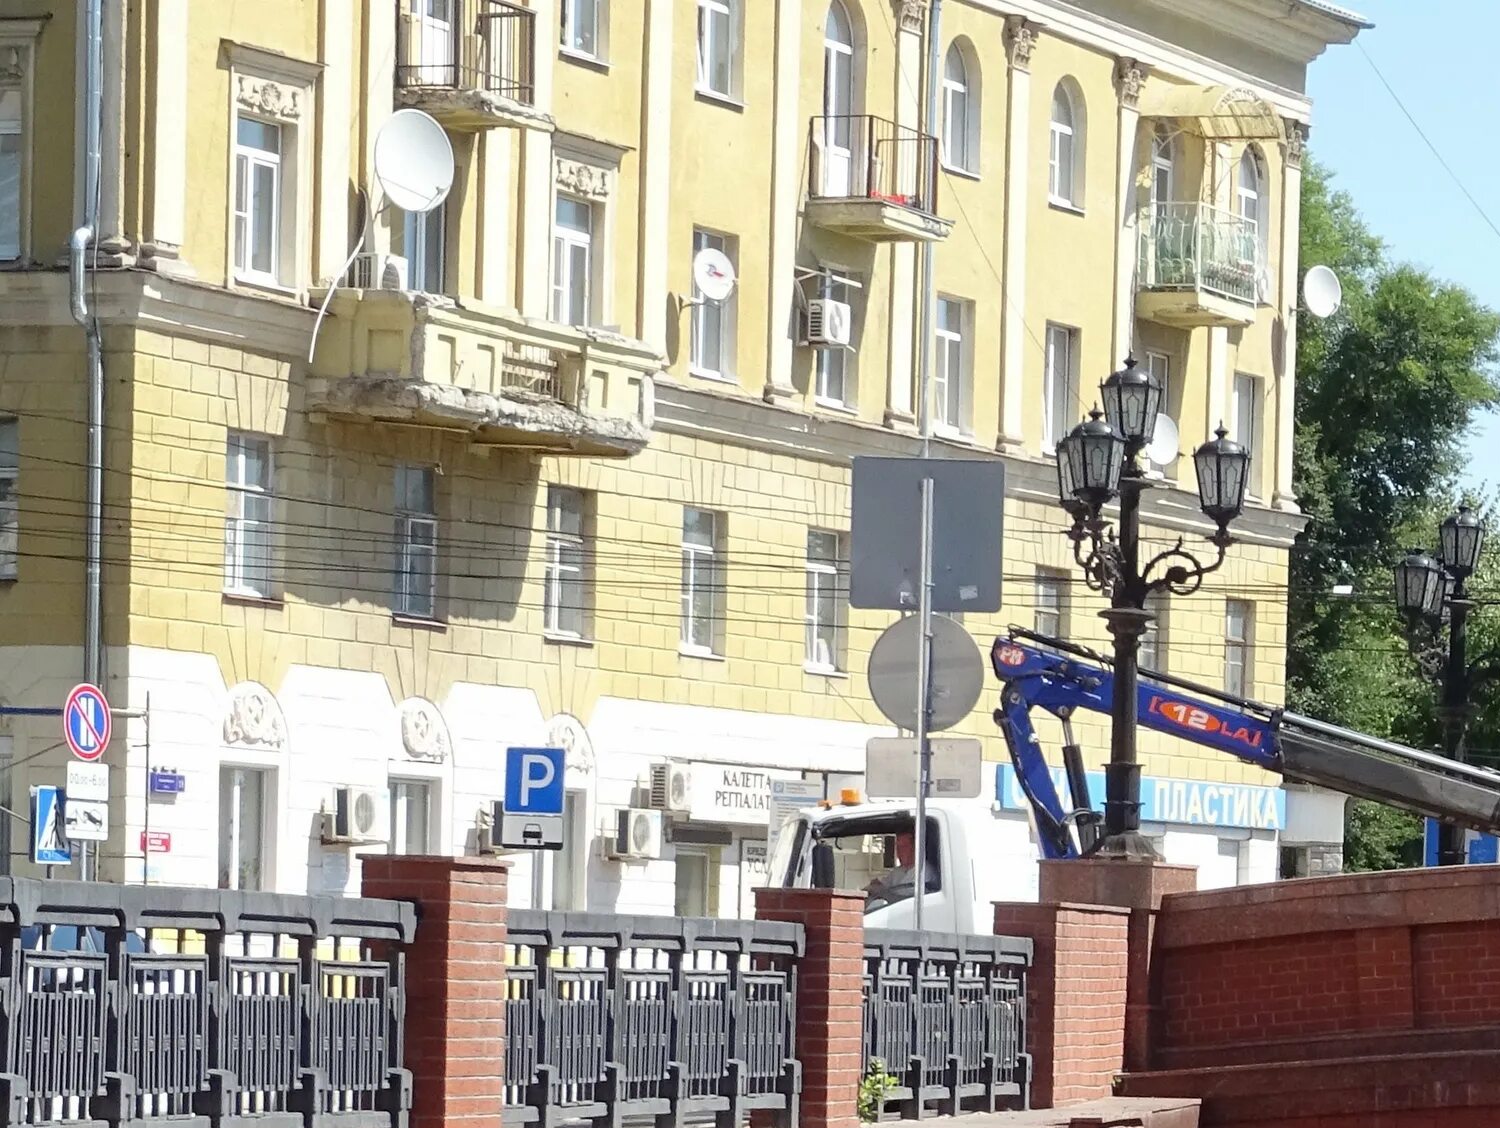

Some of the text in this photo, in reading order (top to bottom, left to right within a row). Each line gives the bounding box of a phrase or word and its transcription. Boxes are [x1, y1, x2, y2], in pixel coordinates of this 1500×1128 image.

[1173, 703, 1210, 730] 12
[520, 753, 555, 807] P
[715, 790, 771, 810] РЕГПАЛАТ
[1154, 780, 1280, 829] ПЛАСТИКА
